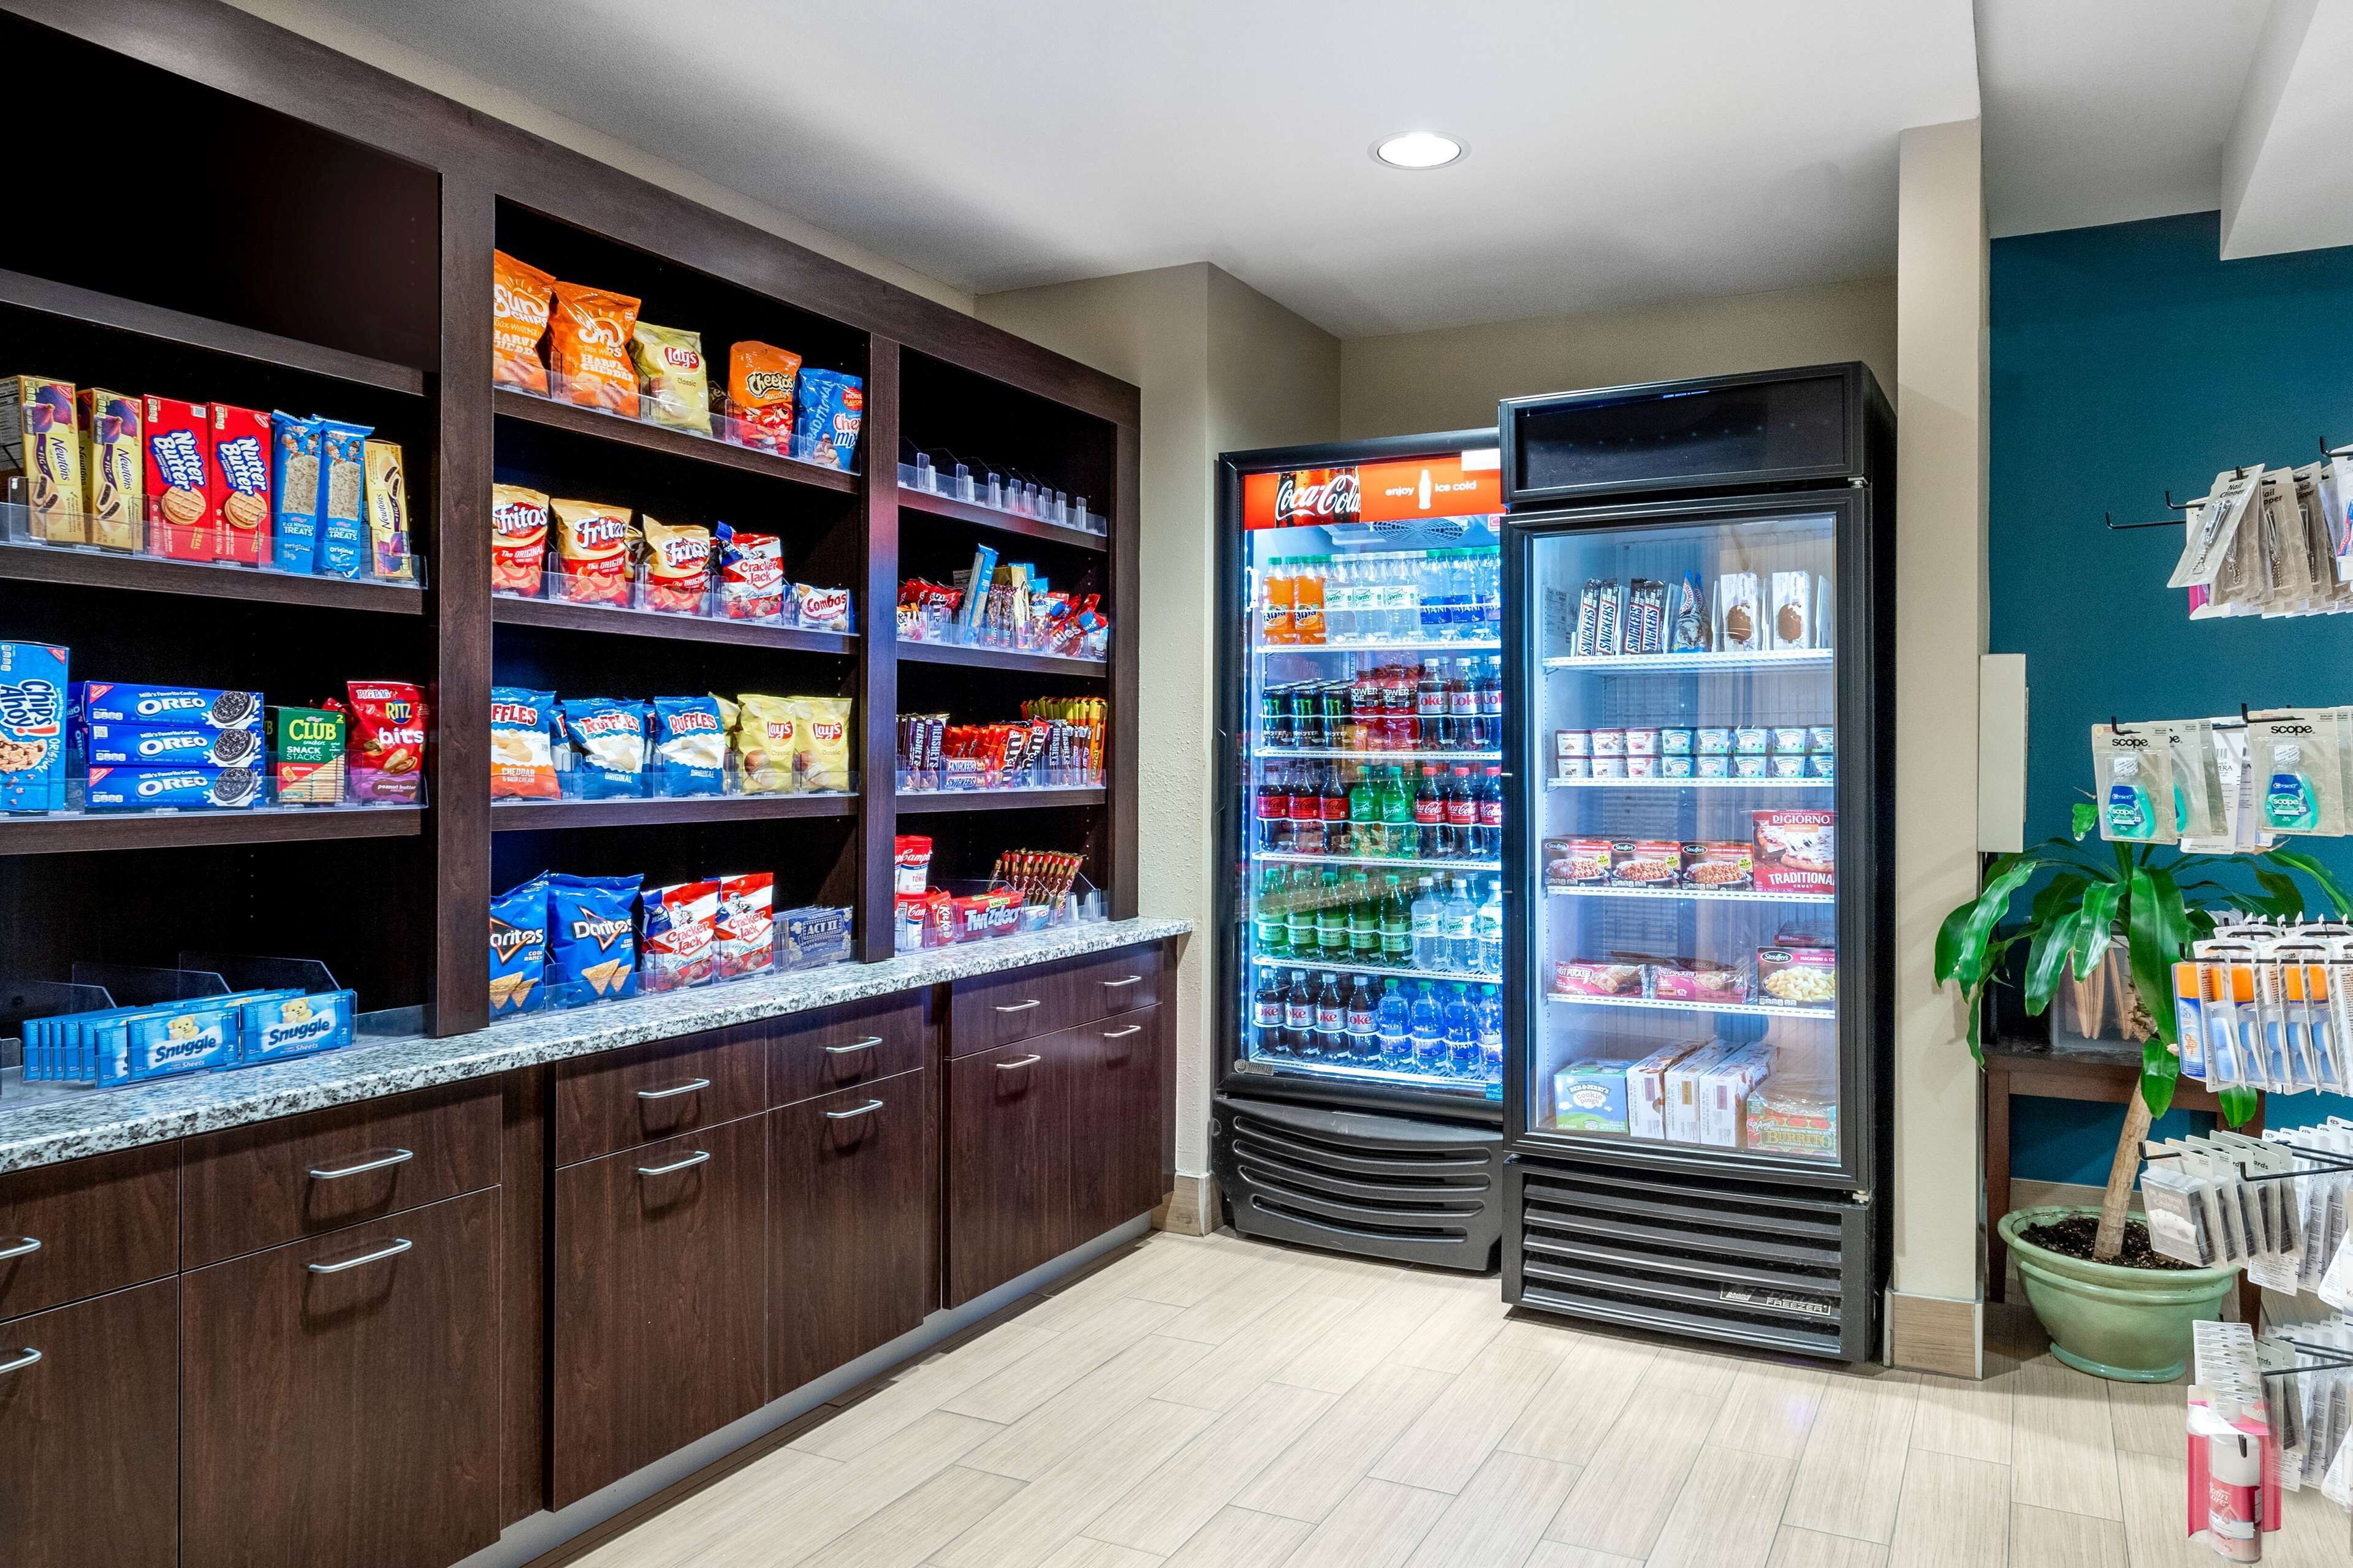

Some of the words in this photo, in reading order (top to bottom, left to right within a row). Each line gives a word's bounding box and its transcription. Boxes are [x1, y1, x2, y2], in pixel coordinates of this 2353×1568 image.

[494, 284, 549, 317] Sun
[511, 309, 547, 328] CHIPS
[677, 377, 697, 387] Classic
[748, 374, 794, 396] Cheetos
[38, 450, 47, 466] FIG
[50, 437, 69, 481] Newtons
[154, 437, 192, 491] Butter
[171, 431, 205, 486] Nutter
[237, 438, 268, 491] Nutter
[117, 448, 132, 491] Newtons
[221, 443, 253, 495] Butter
[1385, 485, 1414, 496] enjoy
[1435, 483, 1450, 493] ice
[1453, 480, 1477, 491] cold
[2219, 488, 2245, 499] Clipper
[2228, 482, 2243, 491] Nail
[1276, 475, 1361, 521] Coca-Cola
[378, 494, 392, 529] Newtons
[493, 504, 547, 534] Fritos
[284, 527, 313, 536] TREATS
[329, 531, 357, 540] TREATS
[284, 543, 310, 552] original
[515, 545, 544, 558] ORIGINAL
[740, 559, 778, 573] Cracker
[746, 572, 771, 585] Jack
[807, 593, 846, 612] Combos
[1325, 593, 1343, 603] Sprite
[1355, 593, 1372, 603] Sprite
[1387, 592, 1404, 602] Sprite
[1580, 608, 1595, 656] SNICKERS
[1599, 604, 1616, 651] SNICKERS
[1627, 605, 1643, 652] SNICKERS
[1644, 608, 1658, 651] SNICKERS
[357, 689, 373, 699] BIG
[373, 689, 390, 699] BAG
[1451, 694, 1480, 706] Coke
[21, 681, 53, 725] Chips
[137, 698, 206, 716] OREO
[385, 703, 412, 720] RITZ
[289, 719, 336, 740] CLUB
[669, 713, 717, 735] RUFFLES
[767, 720, 793, 740] Lay's
[813, 721, 842, 740] Lay's
[2270, 724, 2313, 736] scope
[378, 727, 424, 744] bits
[2112, 738, 2148, 749] scope
[139, 737, 208, 756] OREO
[36, 738, 61, 773] ORIGINAL
[501, 767, 535, 777] CHEDDAR
[950, 760, 976, 773] SNICKERS
[605, 772, 633, 783] ORIGINAL
[946, 777, 976, 788] SNICKERS
[137, 777, 208, 797] OREO
[2273, 798, 2299, 806] scope
[2112, 808, 2134, 817] scope
[728, 911, 766, 929] Cracker
[807, 923, 826, 935] ACT
[827, 920, 838, 931] II
[491, 928, 544, 948] oritos
[666, 922, 709, 943] Cracker
[737, 925, 759, 941] Jack
[673, 936, 702, 955] Jack
[1764, 953, 1789, 962] Stouffer's
[1287, 1008, 1306, 1019] oke
[268, 1018, 330, 1045] Snuggle
[154, 1034, 216, 1062] Snuggle
[295, 1042, 319, 1051] Sheets
[182, 1058, 206, 1069] Sheets
[1755, 1119, 1776, 1132] Amy's
[1766, 1131, 1832, 1148] BURRITO
[1766, 1299, 1823, 1312] FREEZER
